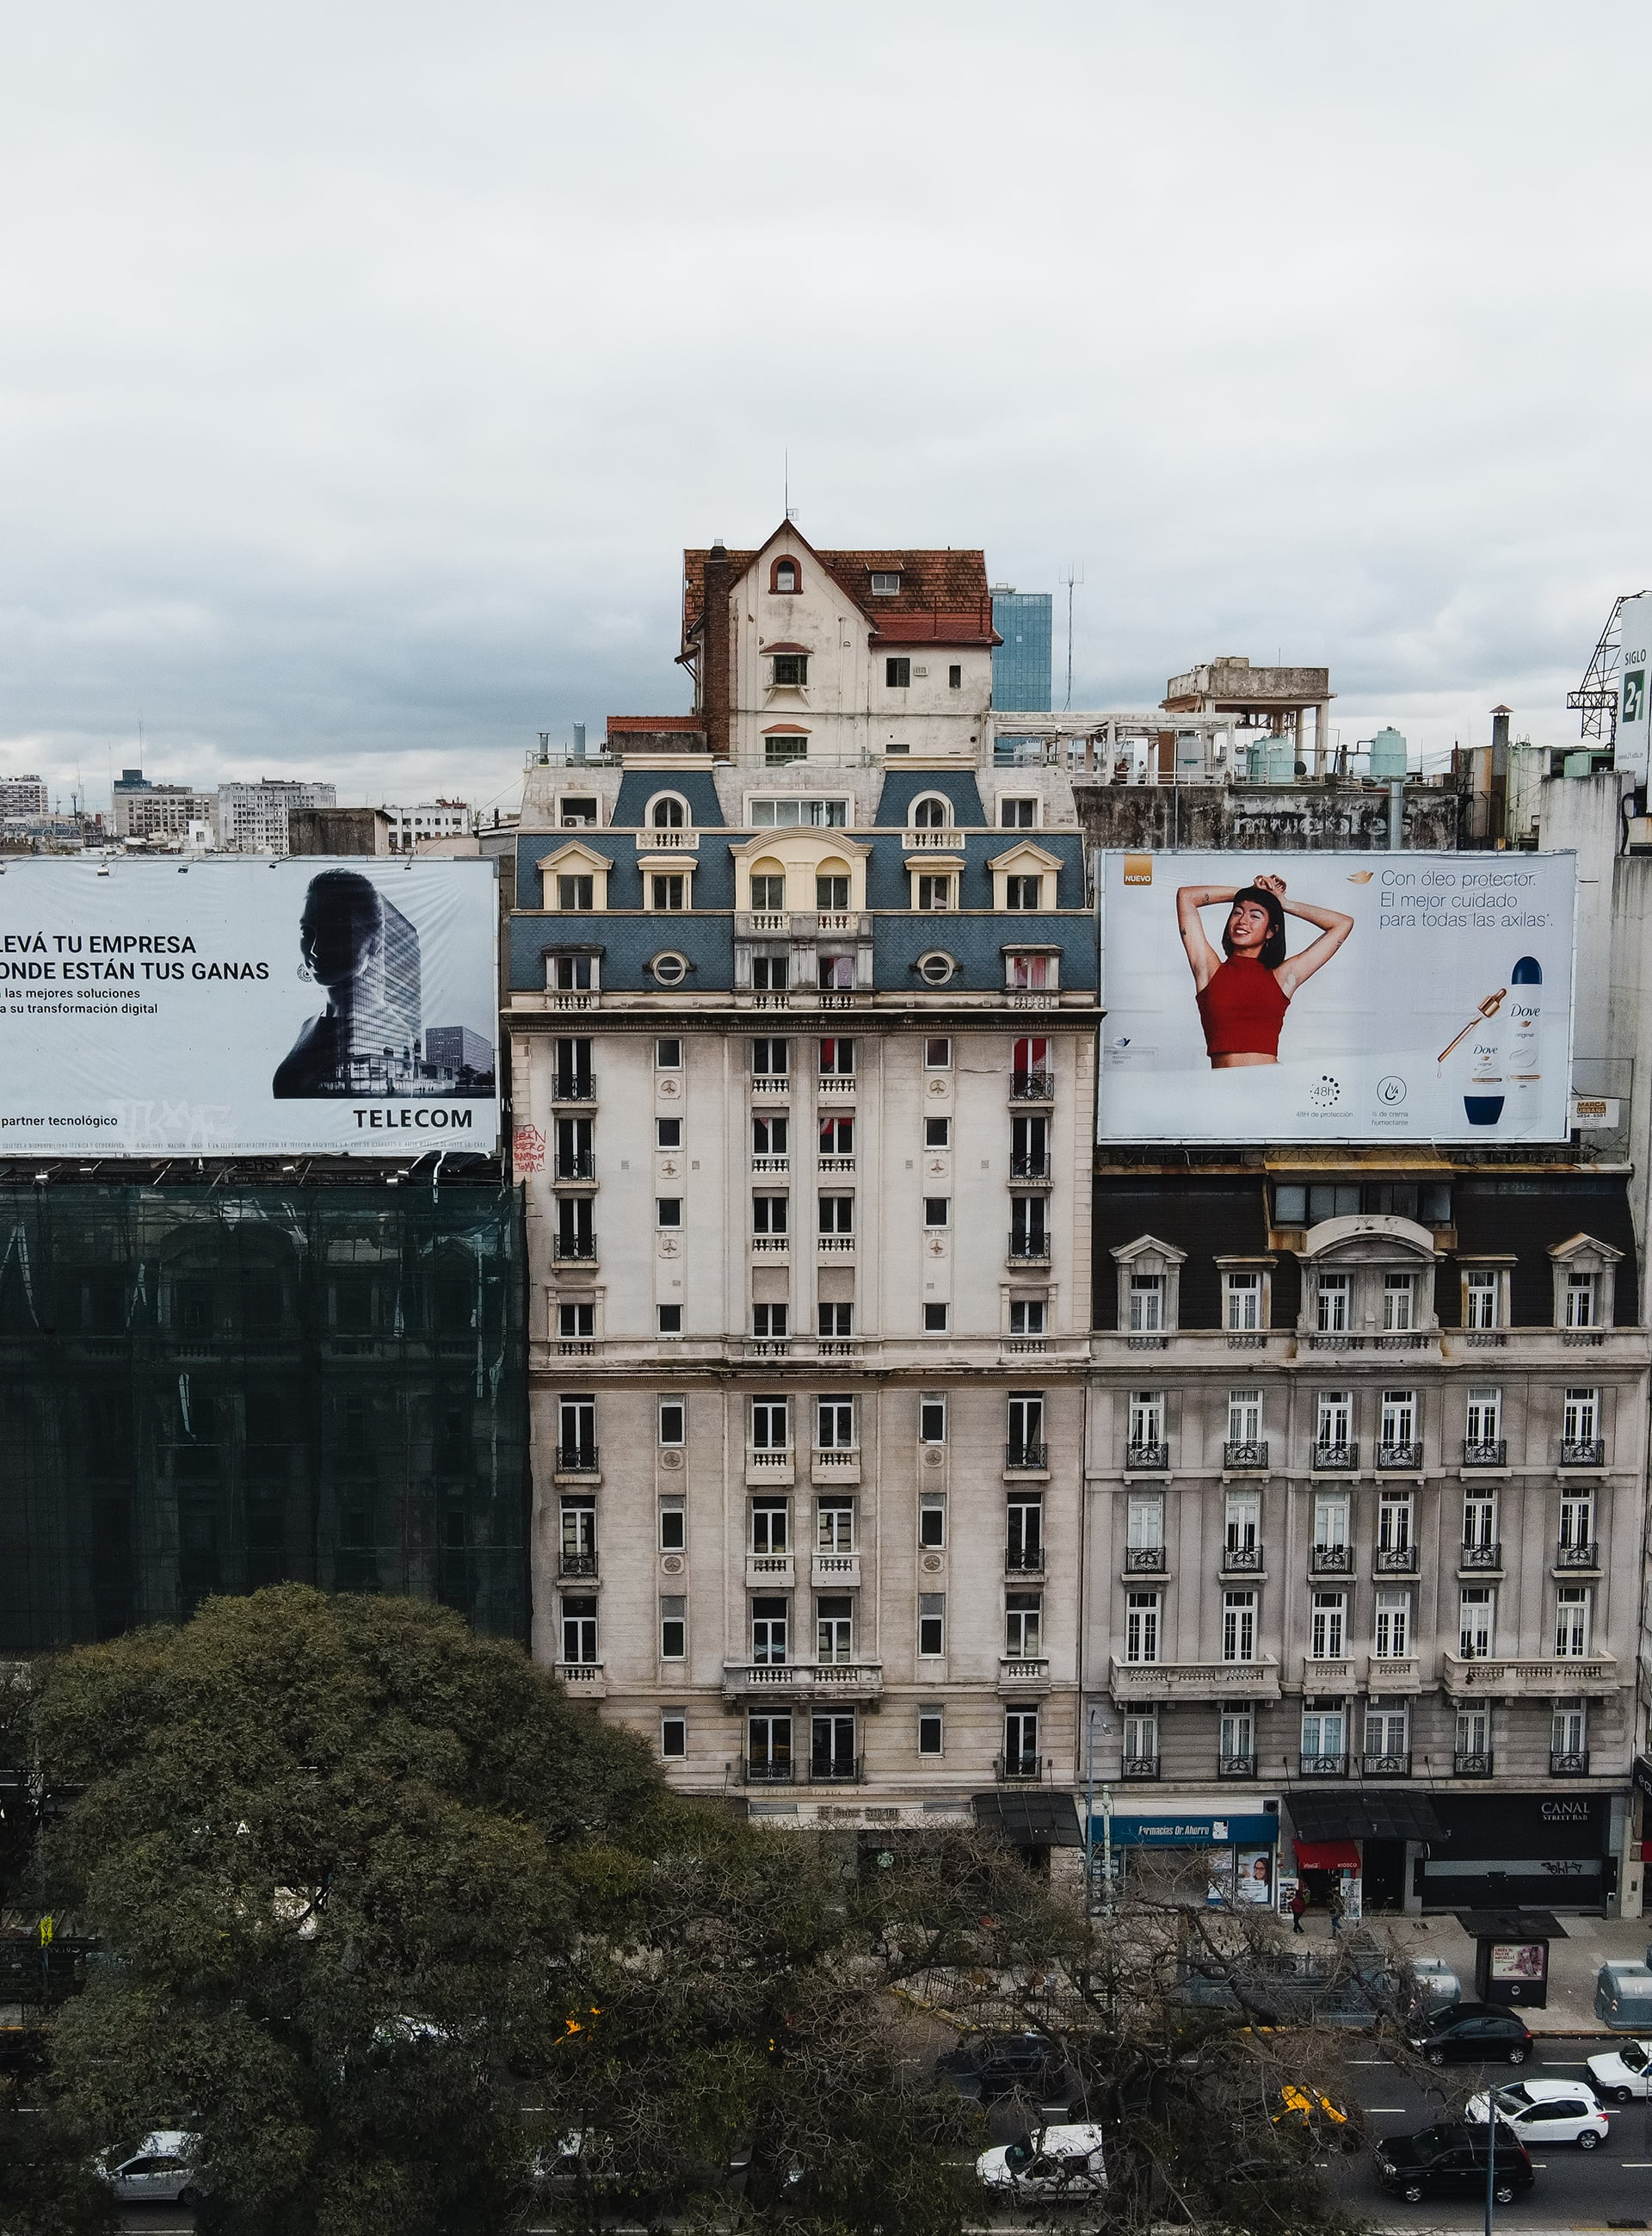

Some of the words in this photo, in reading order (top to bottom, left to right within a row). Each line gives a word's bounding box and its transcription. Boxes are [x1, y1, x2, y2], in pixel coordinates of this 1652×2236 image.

[1624, 649, 1646, 665] SIGLO
[1624, 681, 1643, 720] 21
[1381, 870, 1415, 886] Con
[1421, 870, 1456, 886] óleo
[1462, 871, 1536, 889] protector.
[1381, 892, 1394, 907] El
[1401, 893, 1446, 911] mejor
[1452, 893, 1518, 908] cuidado
[1380, 914, 1415, 929] para
[1422, 912, 1467, 927] todas
[1473, 912, 1495, 927] las
[0, 931, 47, 953] EVÁ
[53, 936, 82, 953] TU
[89, 936, 196, 954] EMPRESA
[63, 958, 134, 979] ESTÁN
[141, 962, 184, 979] TUS
[191, 962, 269, 979] GANAS
[5, 988, 22, 998] las
[26, 988, 73, 1000] mejores
[77, 988, 140, 998] soluciones
[28, 1003, 118, 1014] transformación
[121, 1003, 157, 1016] digital
[1511, 1004, 1541, 1017] Dove
[1473, 1044, 1498, 1054] Dove
[1314, 1086, 1335, 1096] 48h
[2, 1117, 45, 1128] partner
[48, 1115, 118, 1128] tecnológico
[353, 1109, 472, 1127] TELECOM
[1541, 1802, 1590, 1813] CANAL
